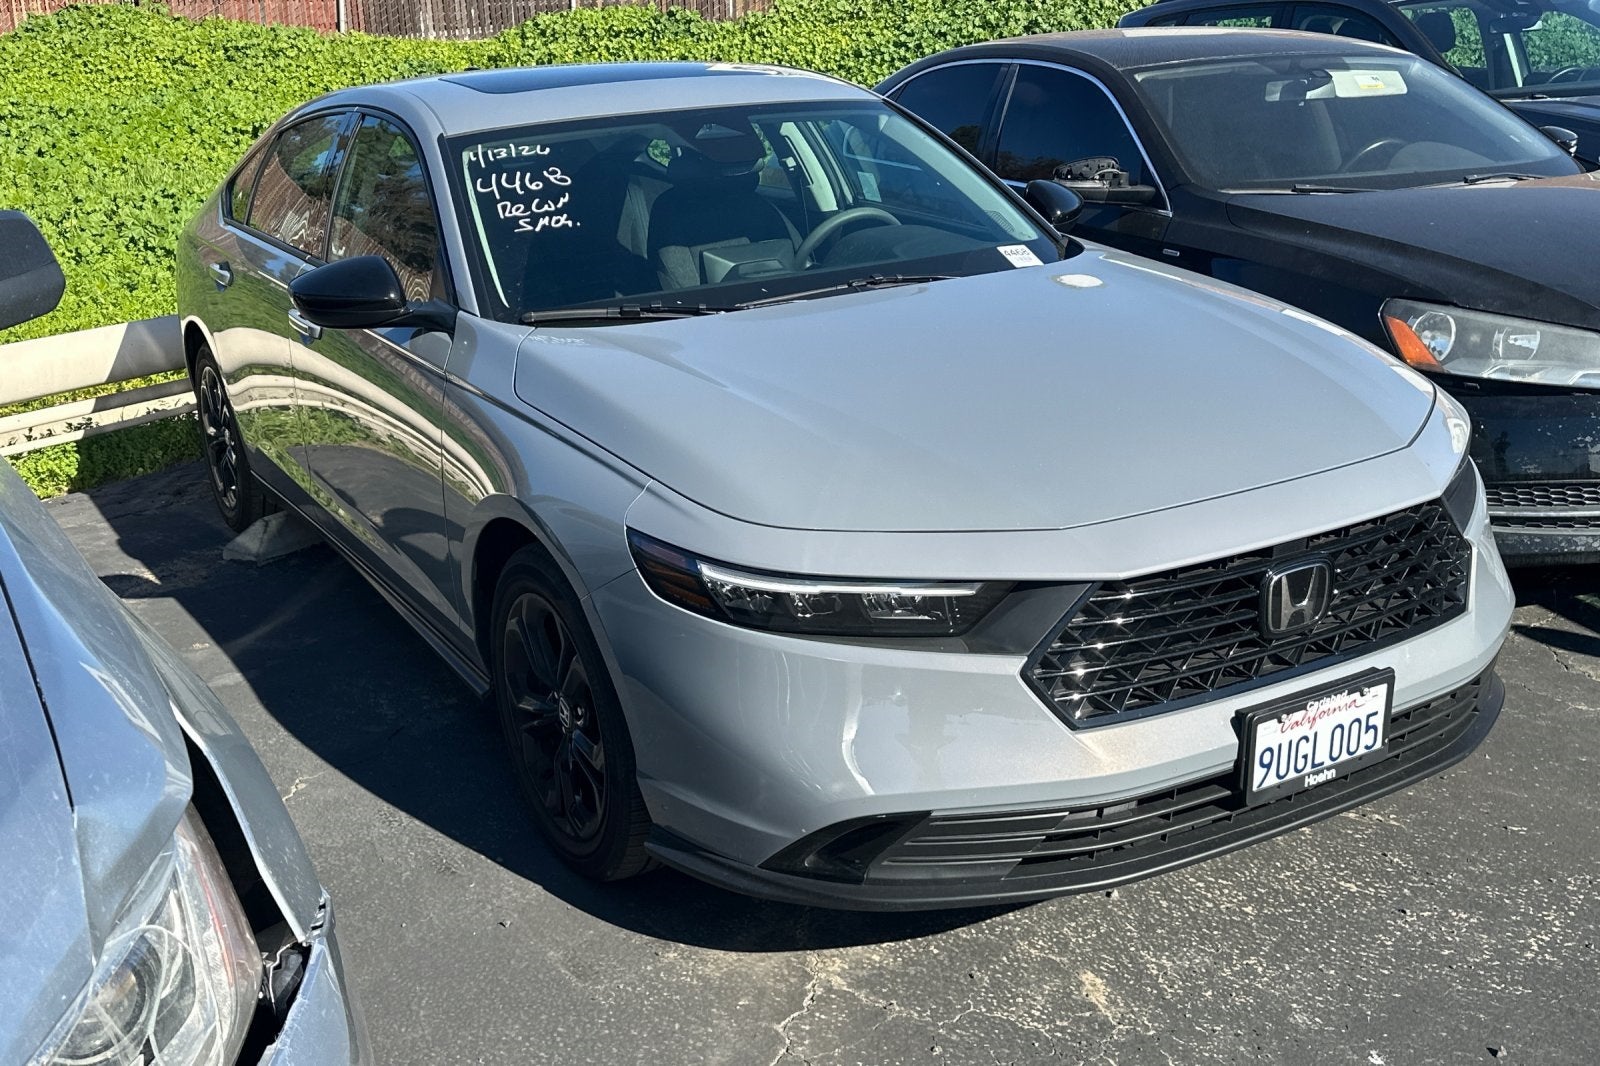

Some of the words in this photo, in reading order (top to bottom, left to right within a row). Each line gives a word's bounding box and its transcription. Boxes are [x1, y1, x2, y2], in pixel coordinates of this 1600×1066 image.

[476, 167, 572, 200] 4468
[1280, 699, 1365, 733] California
[1257, 711, 1378, 788] 9UGL005
[1304, 768, 1336, 787] Hoehn
